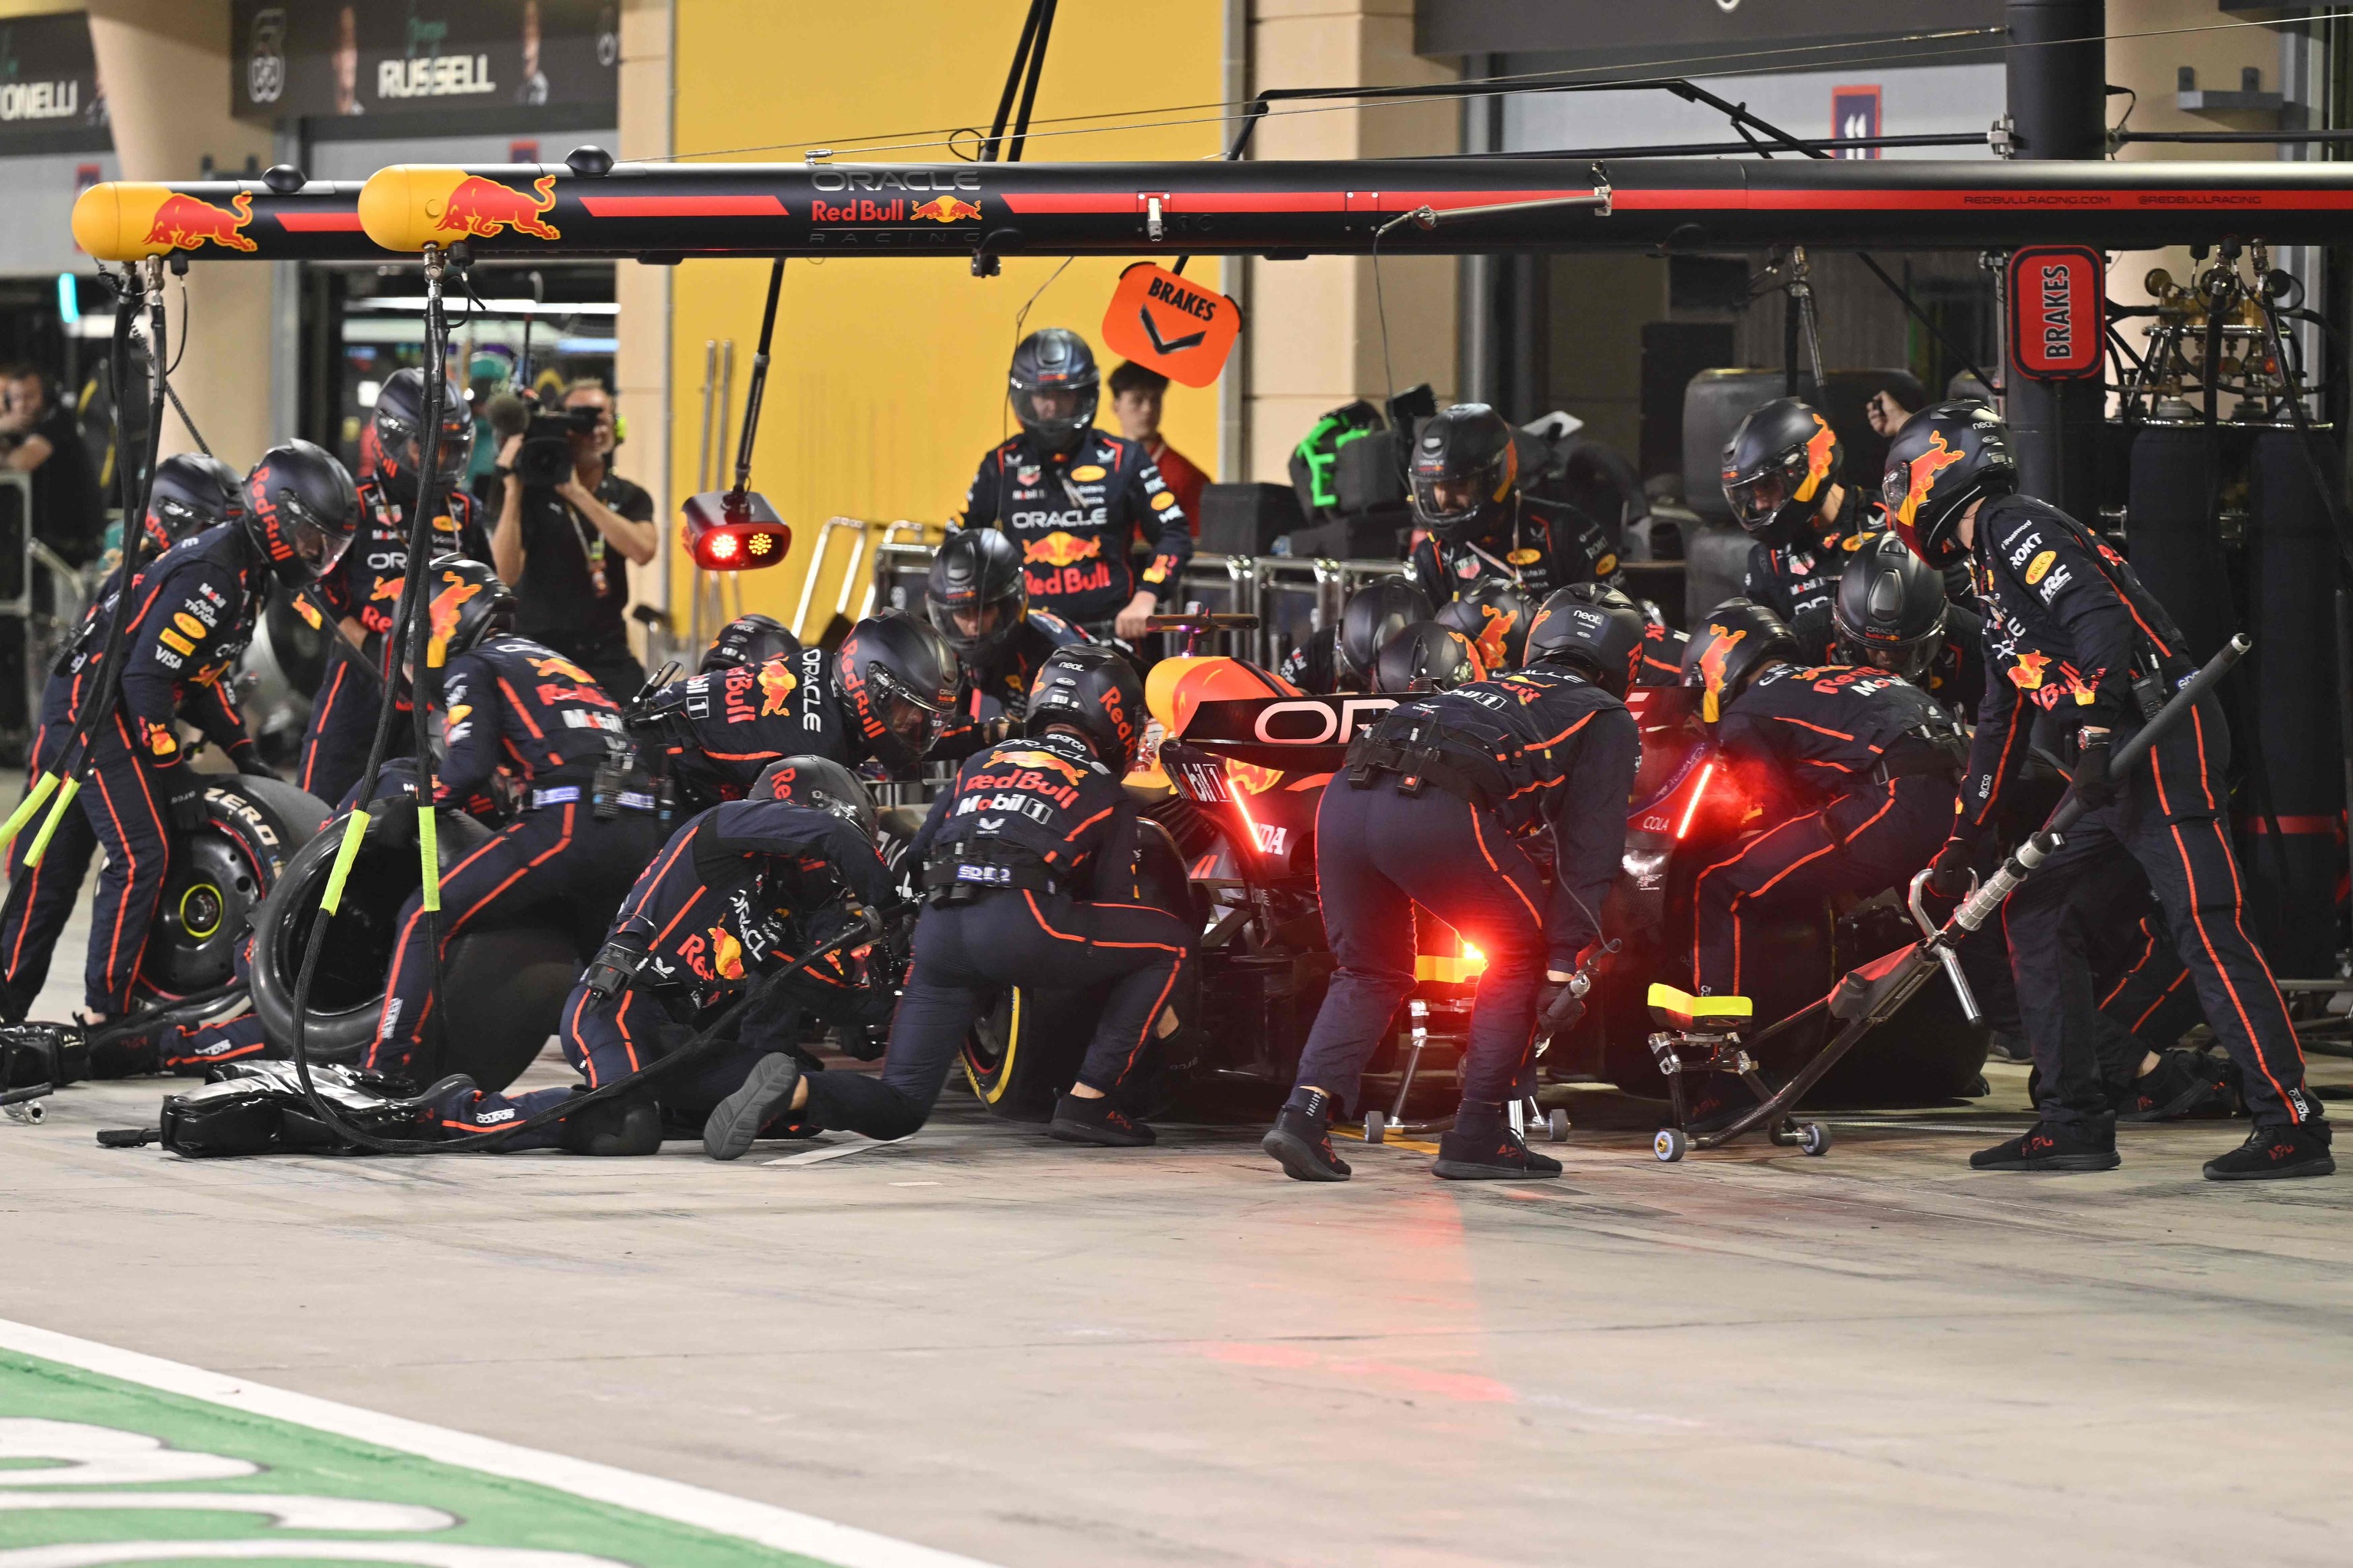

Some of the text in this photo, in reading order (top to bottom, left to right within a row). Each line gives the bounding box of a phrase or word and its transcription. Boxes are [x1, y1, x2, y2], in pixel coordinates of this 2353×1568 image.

[378, 54, 496, 99] RUSSELL
[810, 171, 983, 191] ORACLE
[812, 199, 904, 221] Red Bull
[1964, 195, 2262, 205] REDBULLRACING.COM @REDBULLRACING
[810, 233, 981, 244] RACING
[1147, 277, 1217, 322] BRAKES
[2044, 264, 2073, 360] BRAKES
[1972, 421, 1997, 430] neat
[252, 466, 277, 515] Red
[1012, 507, 1108, 529] ORACLE
[2009, 532, 2043, 570] ROKT
[1023, 561, 1111, 596] Red Bull
[2040, 564, 2070, 601] HRC
[362, 604, 393, 634] Re
[1573, 610, 1602, 624] neat
[1865, 625, 1901, 635] ORACLE
[155, 643, 184, 669] VISA
[842, 640, 866, 691] Red
[1058, 661, 1085, 672] neat
[725, 675, 756, 724] Bull
[801, 648, 822, 733] ORACLE
[1098, 686, 1133, 741] Red
[994, 738, 1111, 776] ORACLE
[1046, 733, 1087, 751] sparco
[770, 767, 797, 804] Re
[964, 768, 1080, 810] Red Bull
[204, 787, 280, 846] ZERO
[955, 793, 1027, 817] Mobil
[1642, 815, 1671, 831] COLA
[476, 1108, 515, 1124] sparco
[2288, 1088, 2310, 1123] sparco
